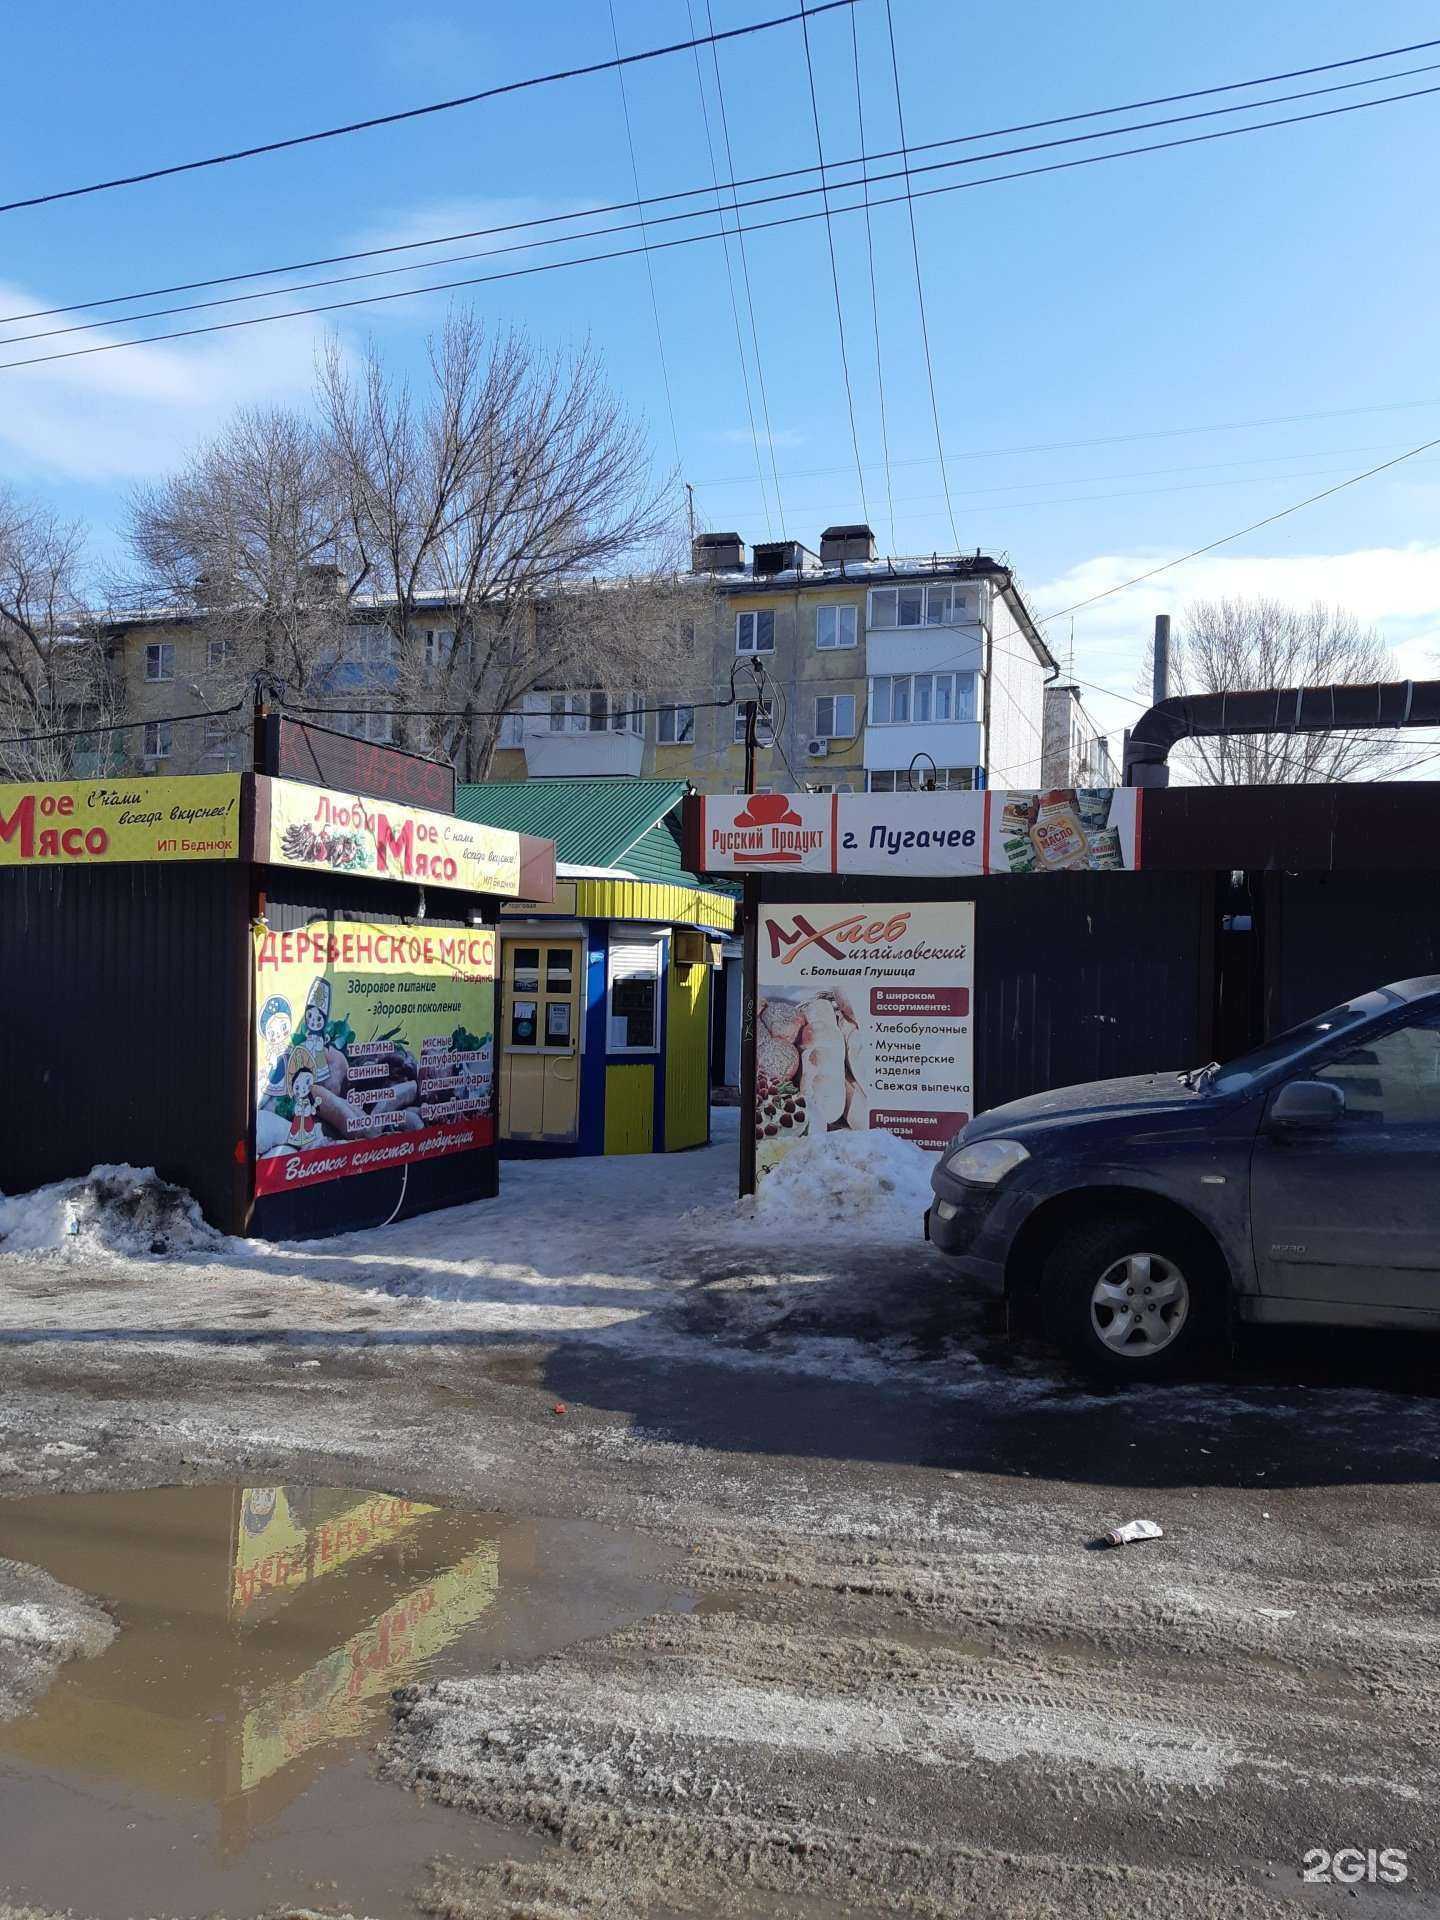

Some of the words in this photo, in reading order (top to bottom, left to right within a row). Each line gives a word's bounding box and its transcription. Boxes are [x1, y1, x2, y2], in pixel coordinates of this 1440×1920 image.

[118, 811, 163, 827] всегда
[169, 799, 235, 824] вкуснее!
[157, 839, 177, 852] ИП
[181, 838, 233, 853] Беднюк
[711, 827, 764, 855] Русский
[771, 827, 824, 854] Продукт
[843, 831, 859, 850] г.
[868, 825, 977, 856] Пугачев
[258, 931, 434, 971] ДЕРЕВЕНСКОЕ
[440, 938, 494, 966] МЯСО
[800, 968, 810, 977] с.
[811, 966, 862, 977] Большая
[864, 966, 916, 979] Глушица
[347, 979, 396, 998] Здоровое
[397, 981, 437, 994] питание
[876, 991, 884, 1001] В
[885, 992, 936, 1004] широком
[416, 1001, 462, 1013] поколение
[876, 1003, 952, 1015] ассортименте:
[875, 1022, 968, 1036] Хлебобулочные
[348, 1041, 394, 1055] телятина
[875, 1040, 922, 1054] Мучные
[422, 1048, 489, 1069] полуфабрикаты
[875, 1054, 956, 1067] кондитерские
[348, 1065, 389, 1080] свинина
[875, 1066, 922, 1078] изделия
[465, 1072, 490, 1090] фарш
[875, 1080, 919, 1093] Свежая
[921, 1082, 970, 1095] выпечка
[347, 1088, 395, 1107] баранина
[348, 1115, 372, 1129] мясо
[374, 1111, 406, 1128] птицы
[876, 1113, 939, 1126] Принимаем
[285, 1156, 348, 1181] Высокое
[351, 1142, 415, 1166] качество
